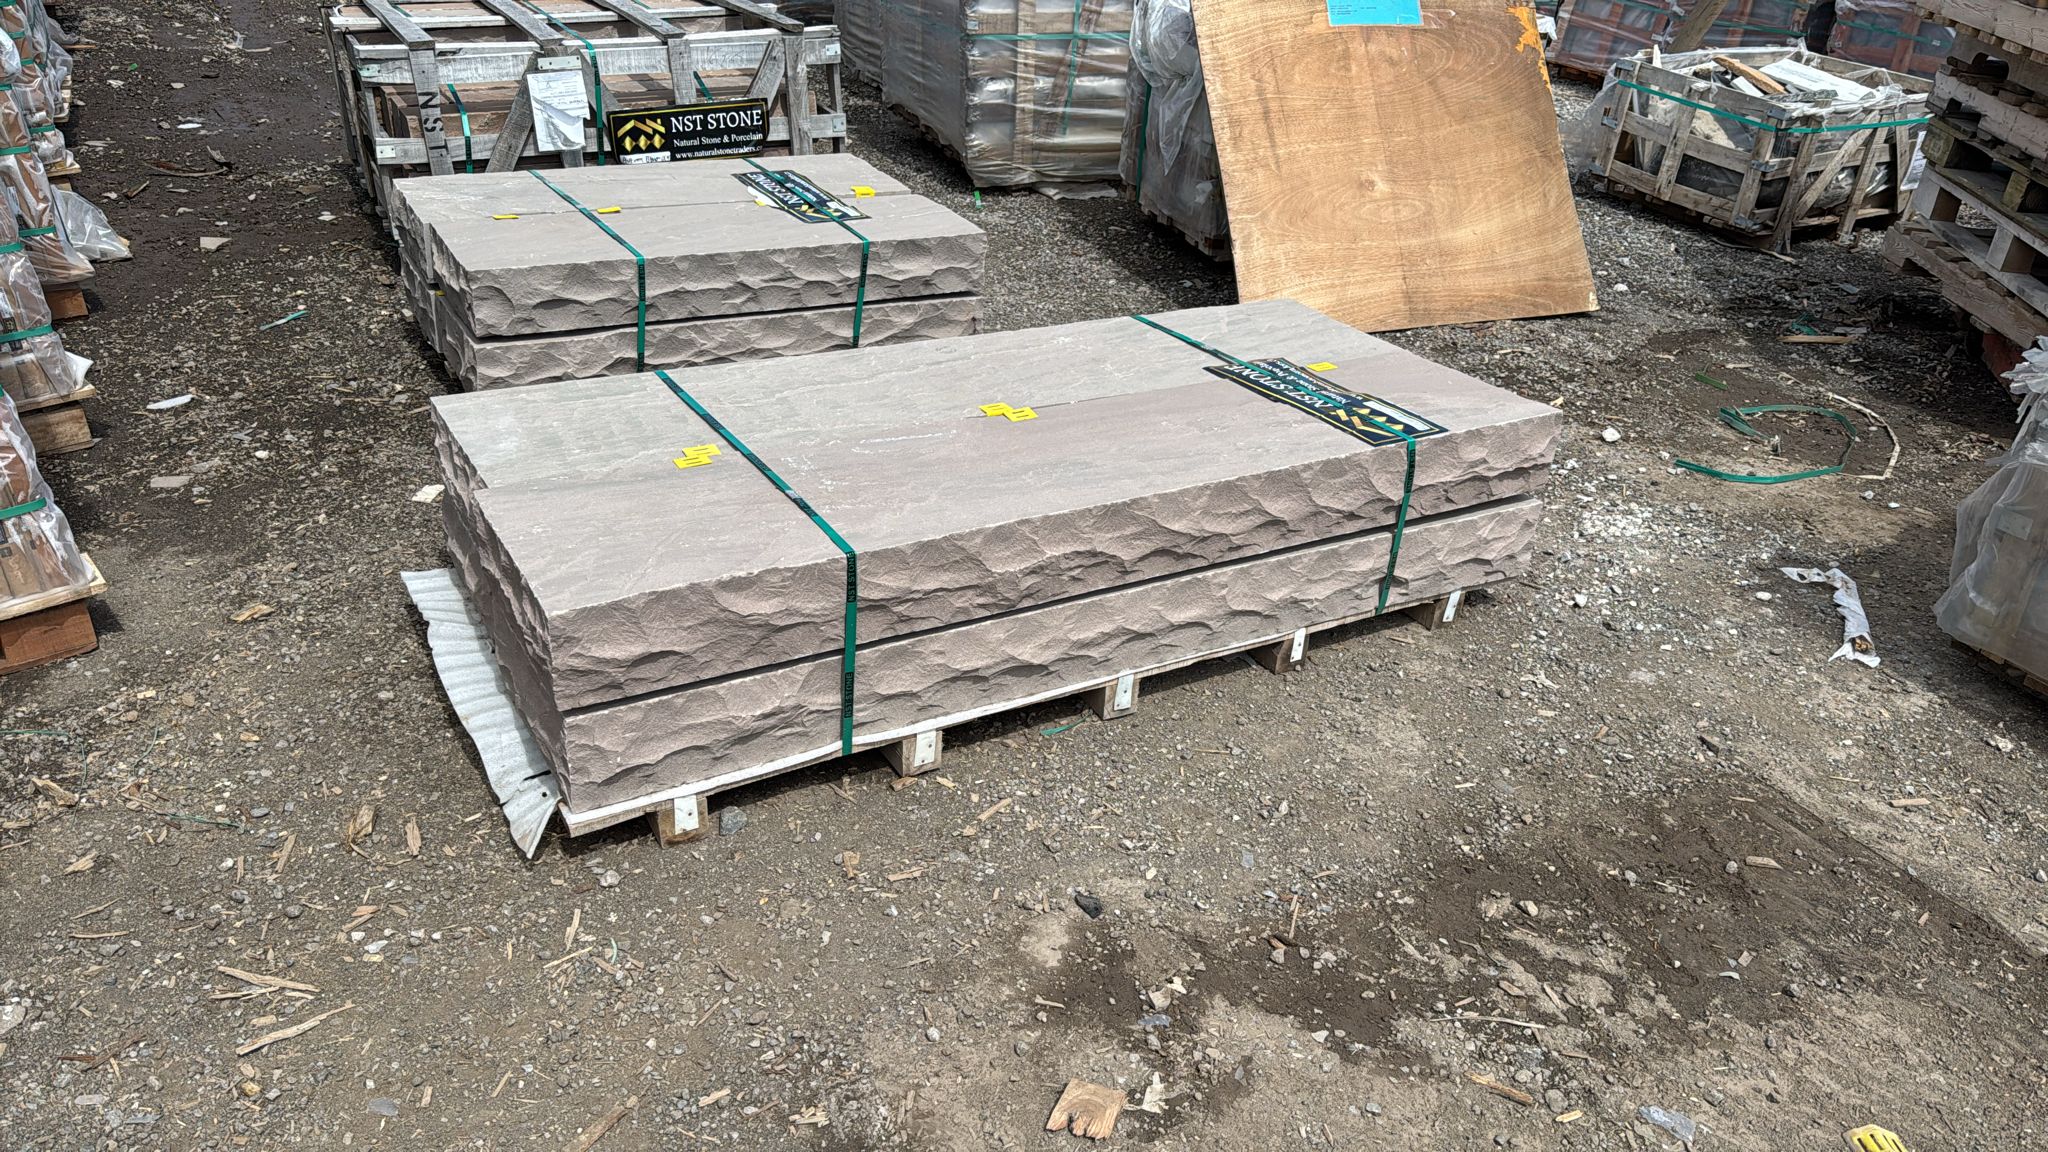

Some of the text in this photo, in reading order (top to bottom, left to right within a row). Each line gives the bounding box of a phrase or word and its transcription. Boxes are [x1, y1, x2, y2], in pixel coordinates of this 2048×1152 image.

[418, 92, 449, 154] NST
[670, 110, 763, 133] NST STONE
[673, 132, 763, 147] Natural Stone & Porcelain
[1284, 390, 1334, 408] NST
[848, 551, 856, 583] STONE
